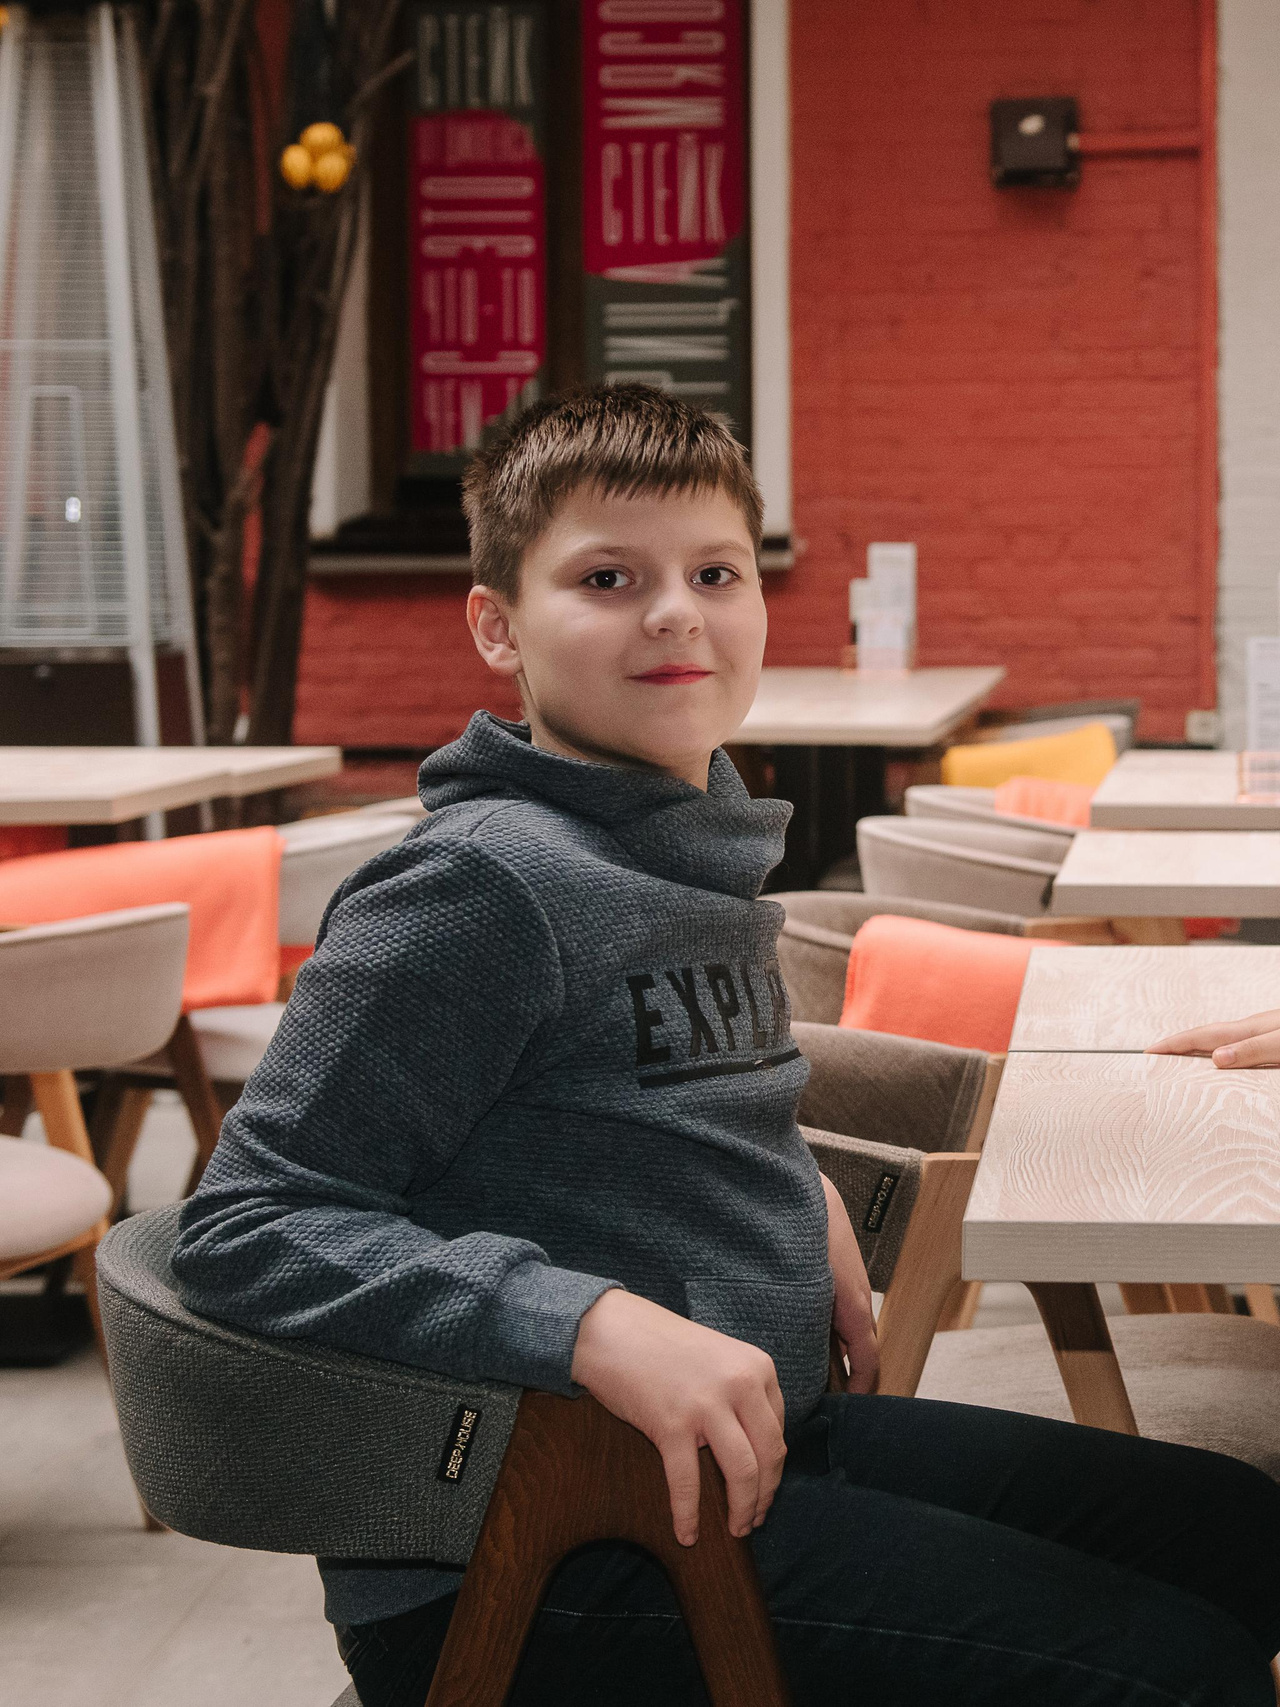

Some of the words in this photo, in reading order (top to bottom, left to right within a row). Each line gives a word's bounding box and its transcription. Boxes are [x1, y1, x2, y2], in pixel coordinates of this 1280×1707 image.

[418, 6, 534, 107] СТЕЙК
[600, 134, 728, 247] СТЕЙК
[603, 258, 739, 400] РИЦА
[445, 1448, 463, 1479] DEEP
